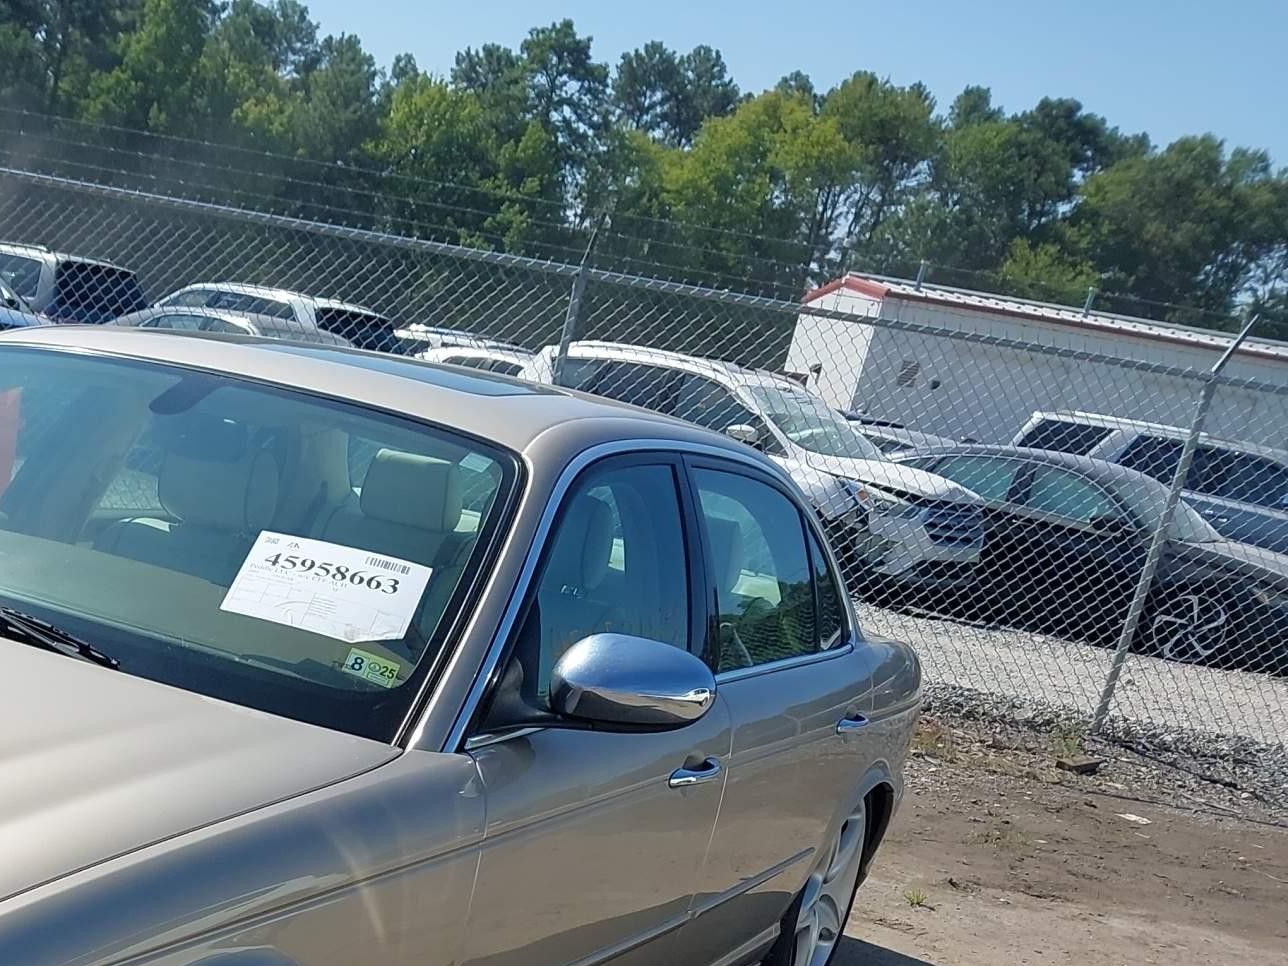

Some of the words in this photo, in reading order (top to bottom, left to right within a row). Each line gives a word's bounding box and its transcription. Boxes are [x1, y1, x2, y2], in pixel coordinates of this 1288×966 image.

[264, 552, 400, 595] 45958663
[351, 656, 365, 671] 8
[380, 665, 397, 680] 25
